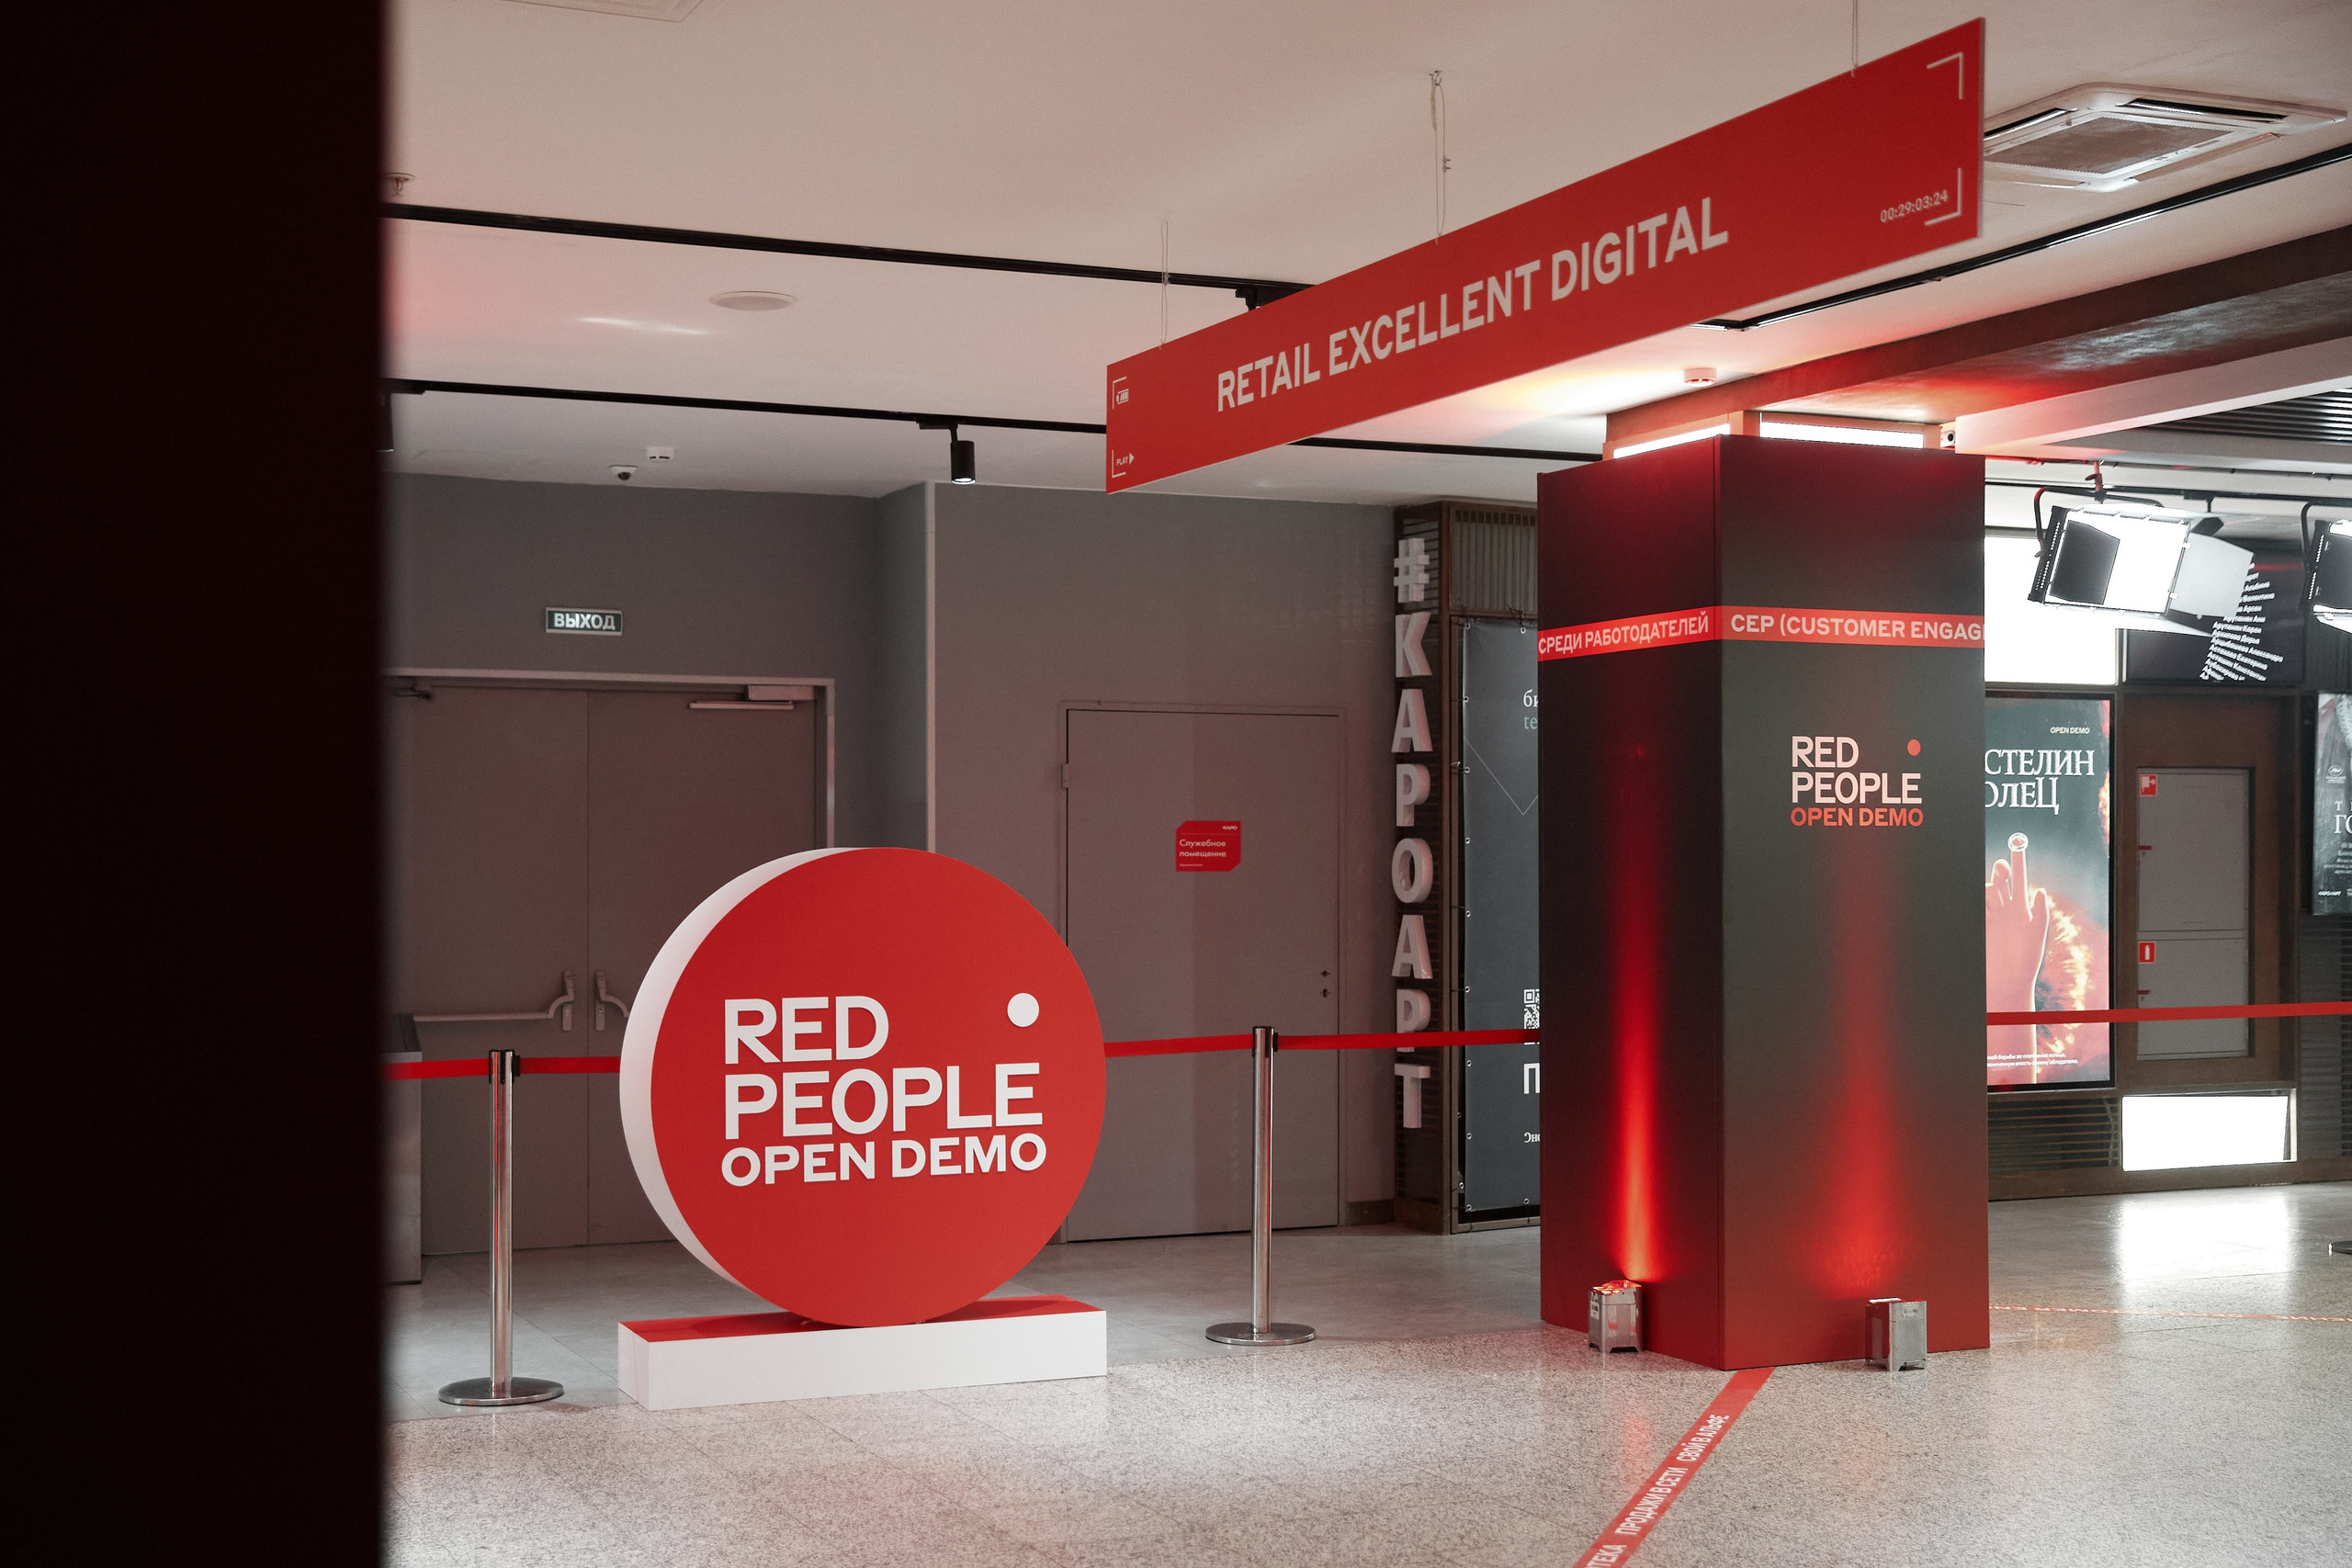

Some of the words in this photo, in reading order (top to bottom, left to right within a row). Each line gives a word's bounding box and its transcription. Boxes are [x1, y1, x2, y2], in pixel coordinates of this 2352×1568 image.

[1880, 189, 1949, 223] 00:29:03:24
[1217, 343, 1320, 412] RETAIL
[1329, 260, 1541, 377] EXCELLENT
[1551, 197, 1729, 301] DIGITAL
[1116, 456, 1129, 466] PLAY
[554, 613, 616, 630] ВЫХОД
[1538, 630, 1582, 654] СРЕДИ
[1585, 610, 1709, 649] РАБОТОДАТЕЛЕЙ
[1731, 614, 1775, 633] CEP
[1780, 614, 1905, 638] (CUSTOMER
[1910, 621, 1985, 641] ENGAG
[1792, 736, 1860, 768] RED
[1984, 749, 2095, 775] СТЕЛИН
[1792, 772, 1922, 805] PEOPLE
[1791, 807, 1853, 827] OPEN
[1859, 807, 1924, 827] DEMO
[1179, 839, 1226, 848] Служебное
[725, 996, 889, 1064] RED
[725, 1062, 1043, 1140] PEOPLE
[721, 1141, 876, 1187] OPEN
[891, 1133, 1046, 1179] DEMO
[1584, 1544, 1627, 1568] ТЕКА
[1614, 1493, 1668, 1535] ПРОДАЖИ
[1655, 1466, 1689, 1487] СЕТИ
[1675, 1441, 1708, 1461] СВОЙ
[1695, 1414, 1730, 1438] АЛЬФЕ
